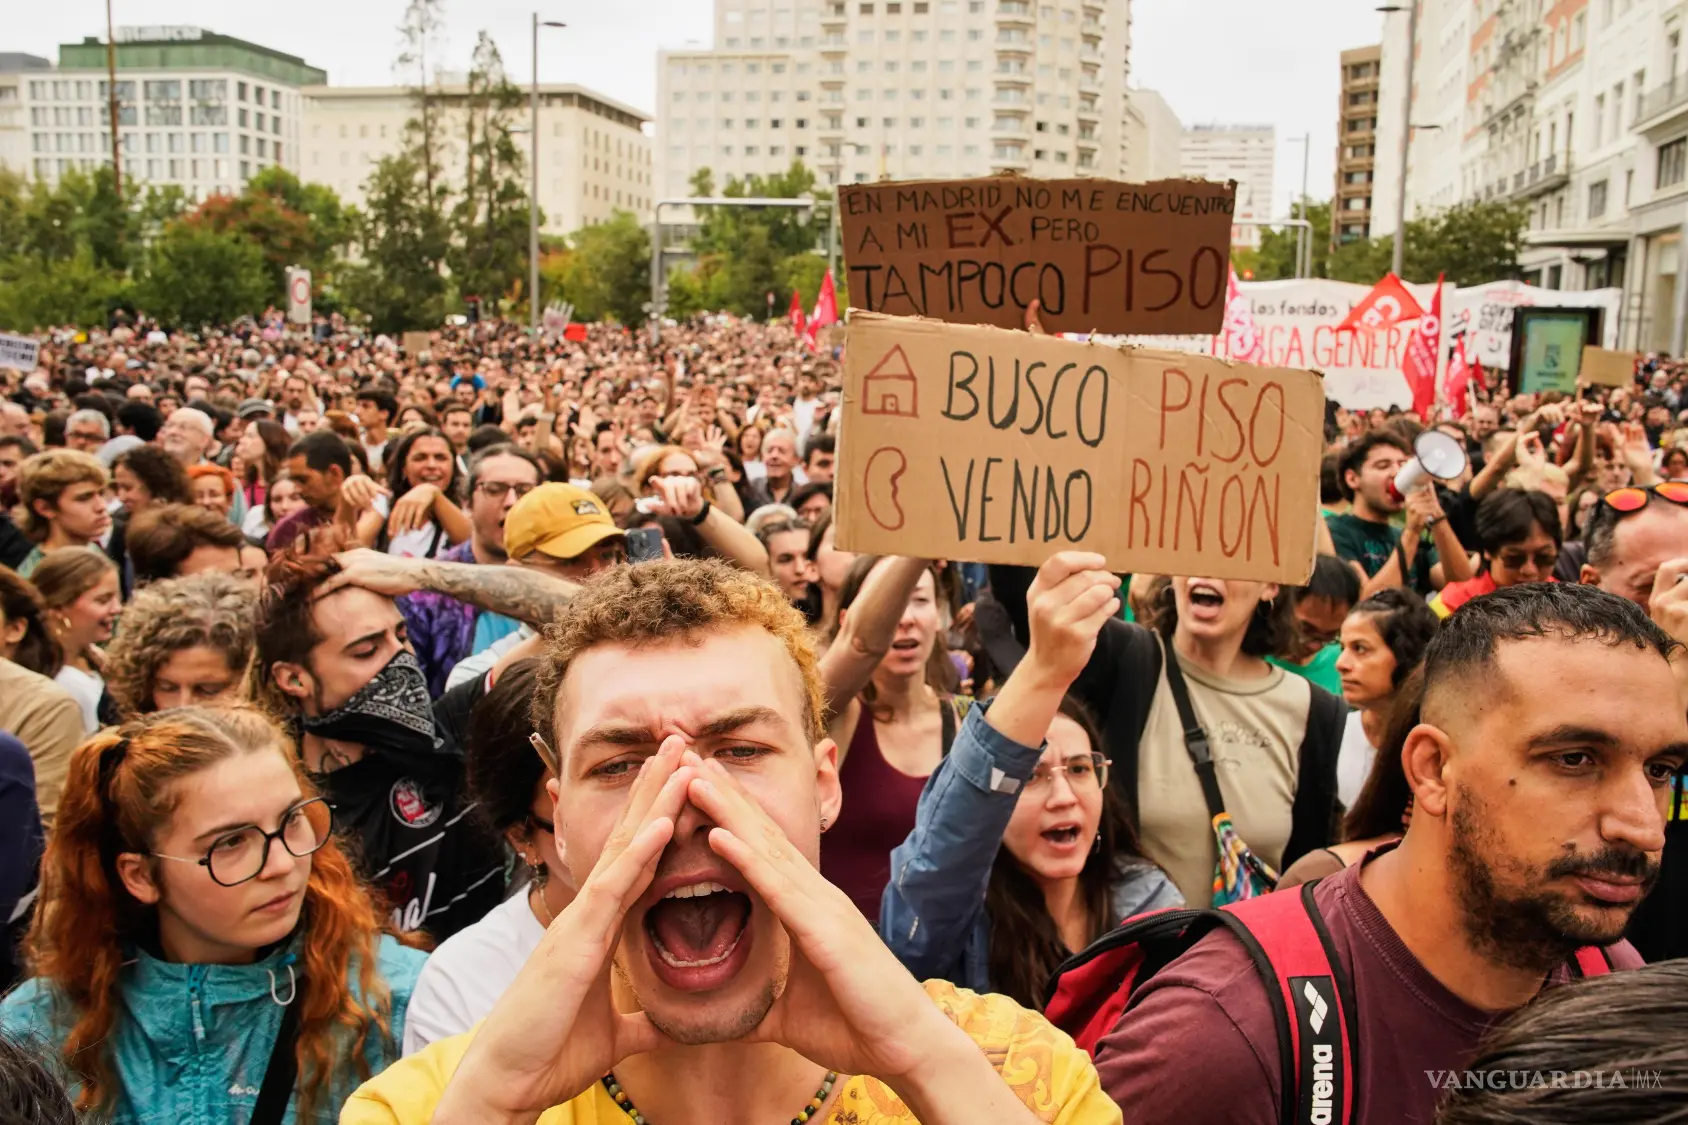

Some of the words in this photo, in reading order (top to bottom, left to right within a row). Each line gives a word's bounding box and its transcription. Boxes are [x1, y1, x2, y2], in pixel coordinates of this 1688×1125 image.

[847, 190, 882, 215] EN
[896, 186, 1001, 212] MADRID
[1016, 186, 1051, 210] NO
[1062, 189, 1104, 211] ME
[1115, 191, 1235, 216] ENCUENTRO
[858, 225, 884, 254] A
[896, 221, 928, 249] MI
[1030, 215, 1100, 243] PERO
[849, 259, 1066, 315] TAMPOCO
[1081, 244, 1224, 315] PISO
[940, 350, 1108, 448] BUSCO
[1158, 368, 1285, 467] PISO
[940, 456, 1093, 544] VENDO
[1127, 458, 1281, 567] RIÑÓN
[1310, 1044, 1334, 1125] arena
